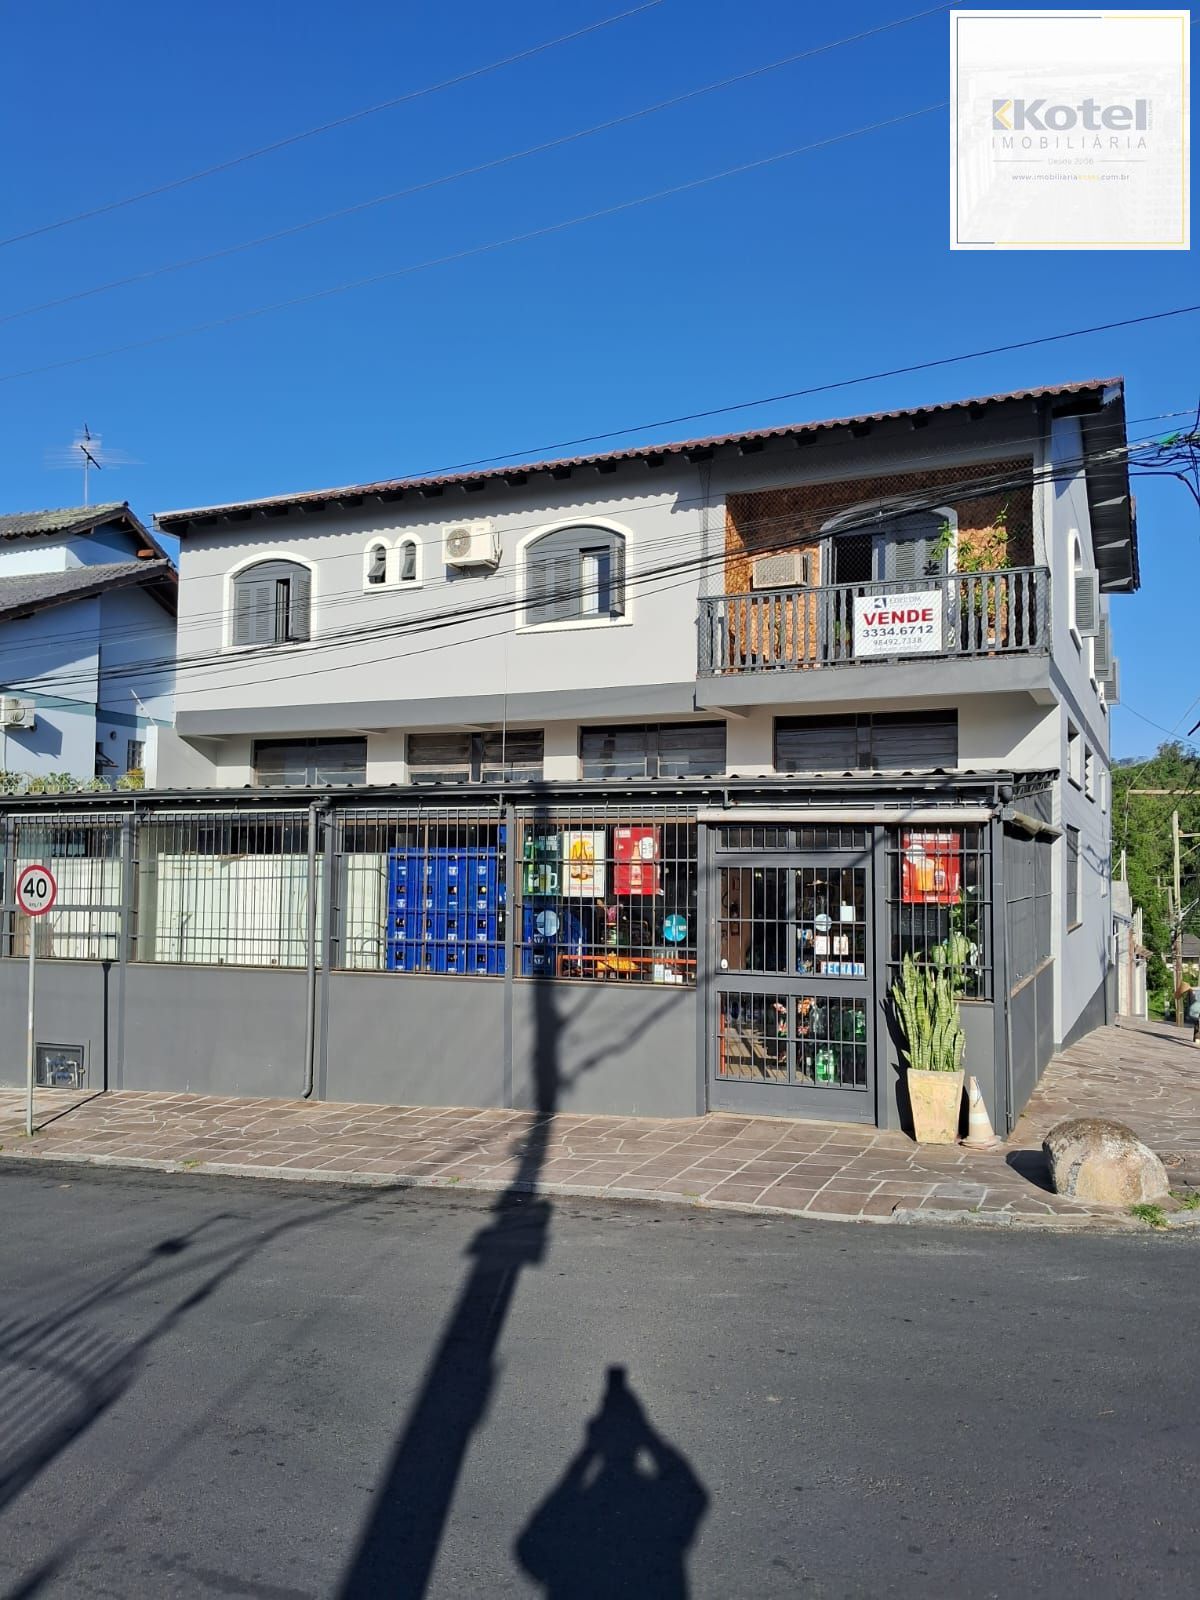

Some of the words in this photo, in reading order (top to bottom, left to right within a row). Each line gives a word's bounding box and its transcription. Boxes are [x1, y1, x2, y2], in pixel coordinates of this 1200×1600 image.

[863, 608, 934, 626] VENDE
[862, 625, 933, 638] 3334.6712
[23, 877, 47, 898] 40
